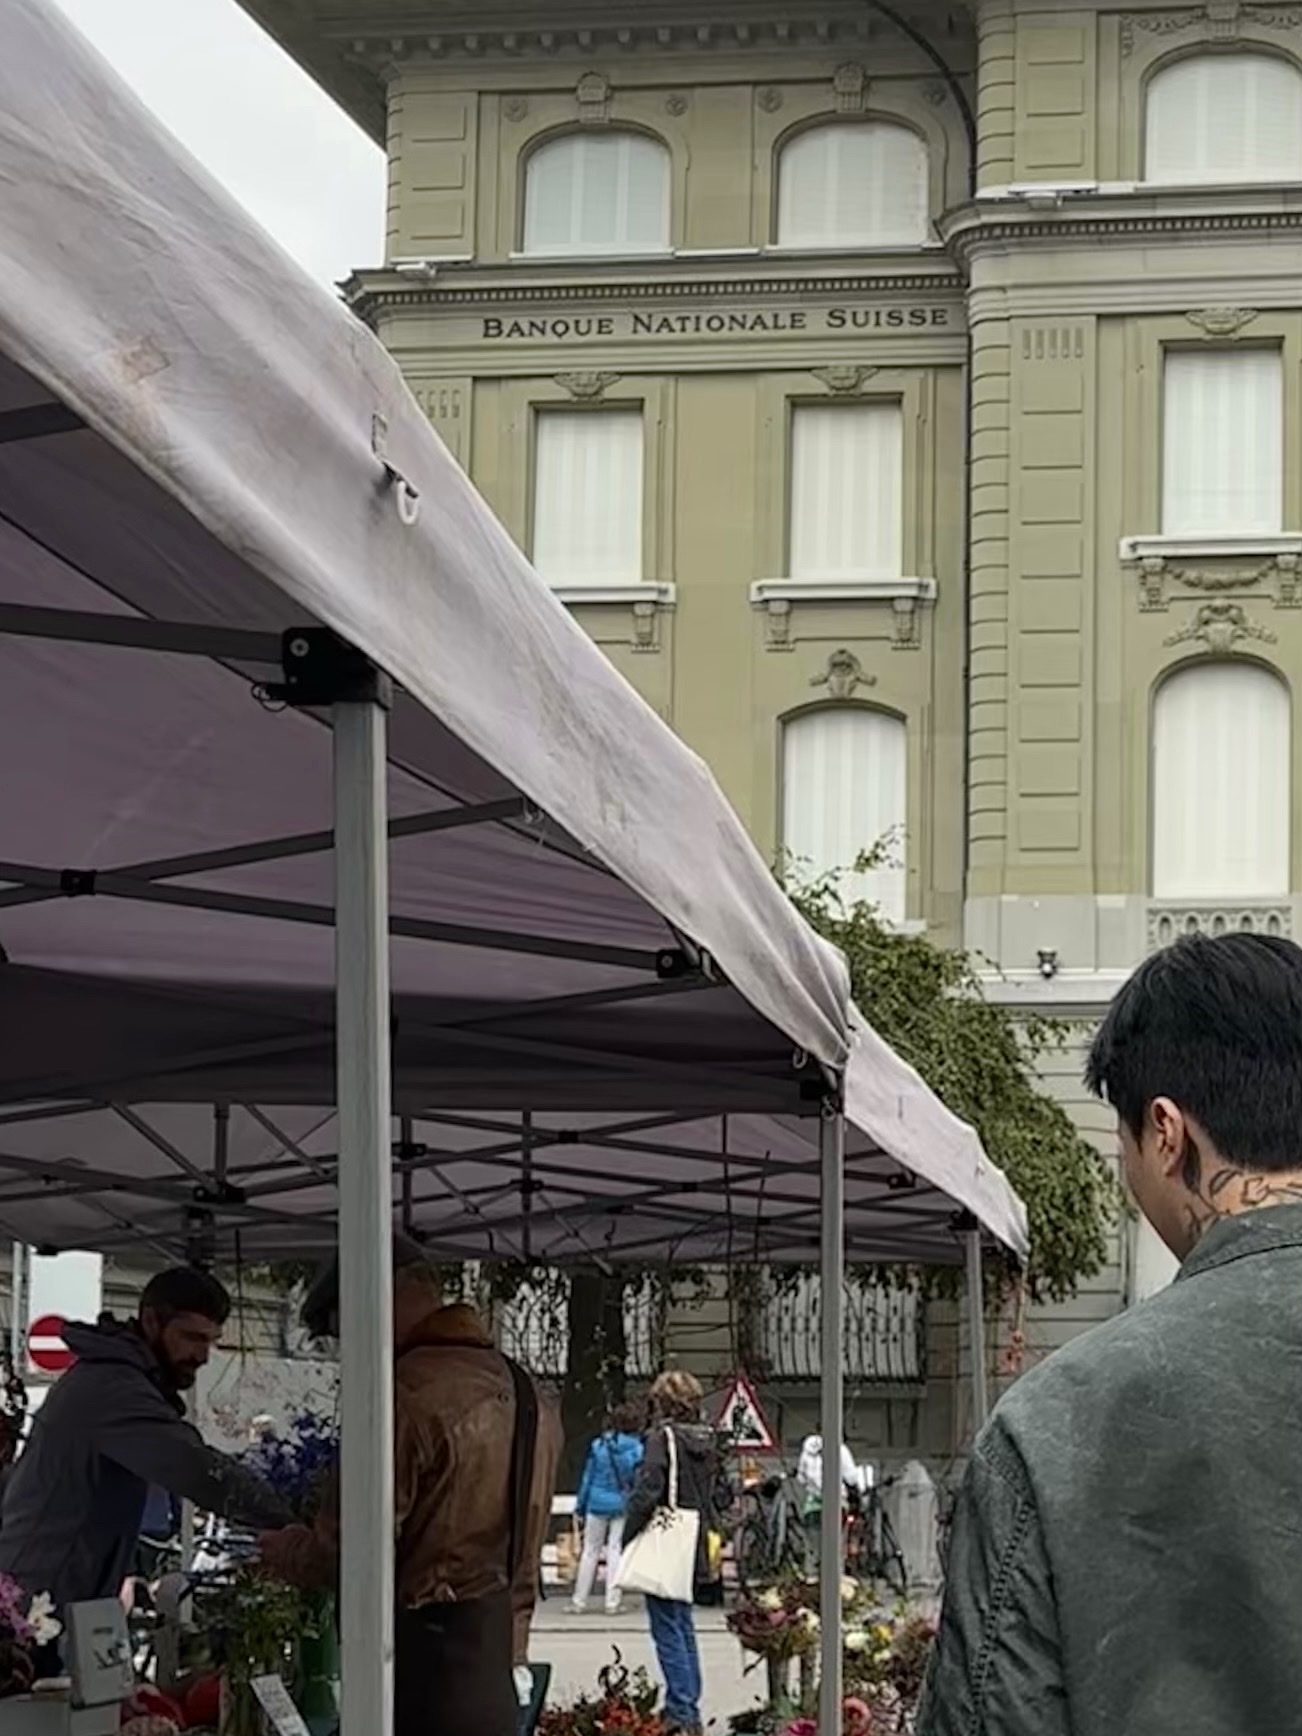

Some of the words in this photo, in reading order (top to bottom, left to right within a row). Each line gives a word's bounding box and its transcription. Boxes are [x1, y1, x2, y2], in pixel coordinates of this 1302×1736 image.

[482, 317, 615, 339] BANQUE
[631, 312, 808, 334] NATIONALE
[825, 307, 949, 328] SUISSE
